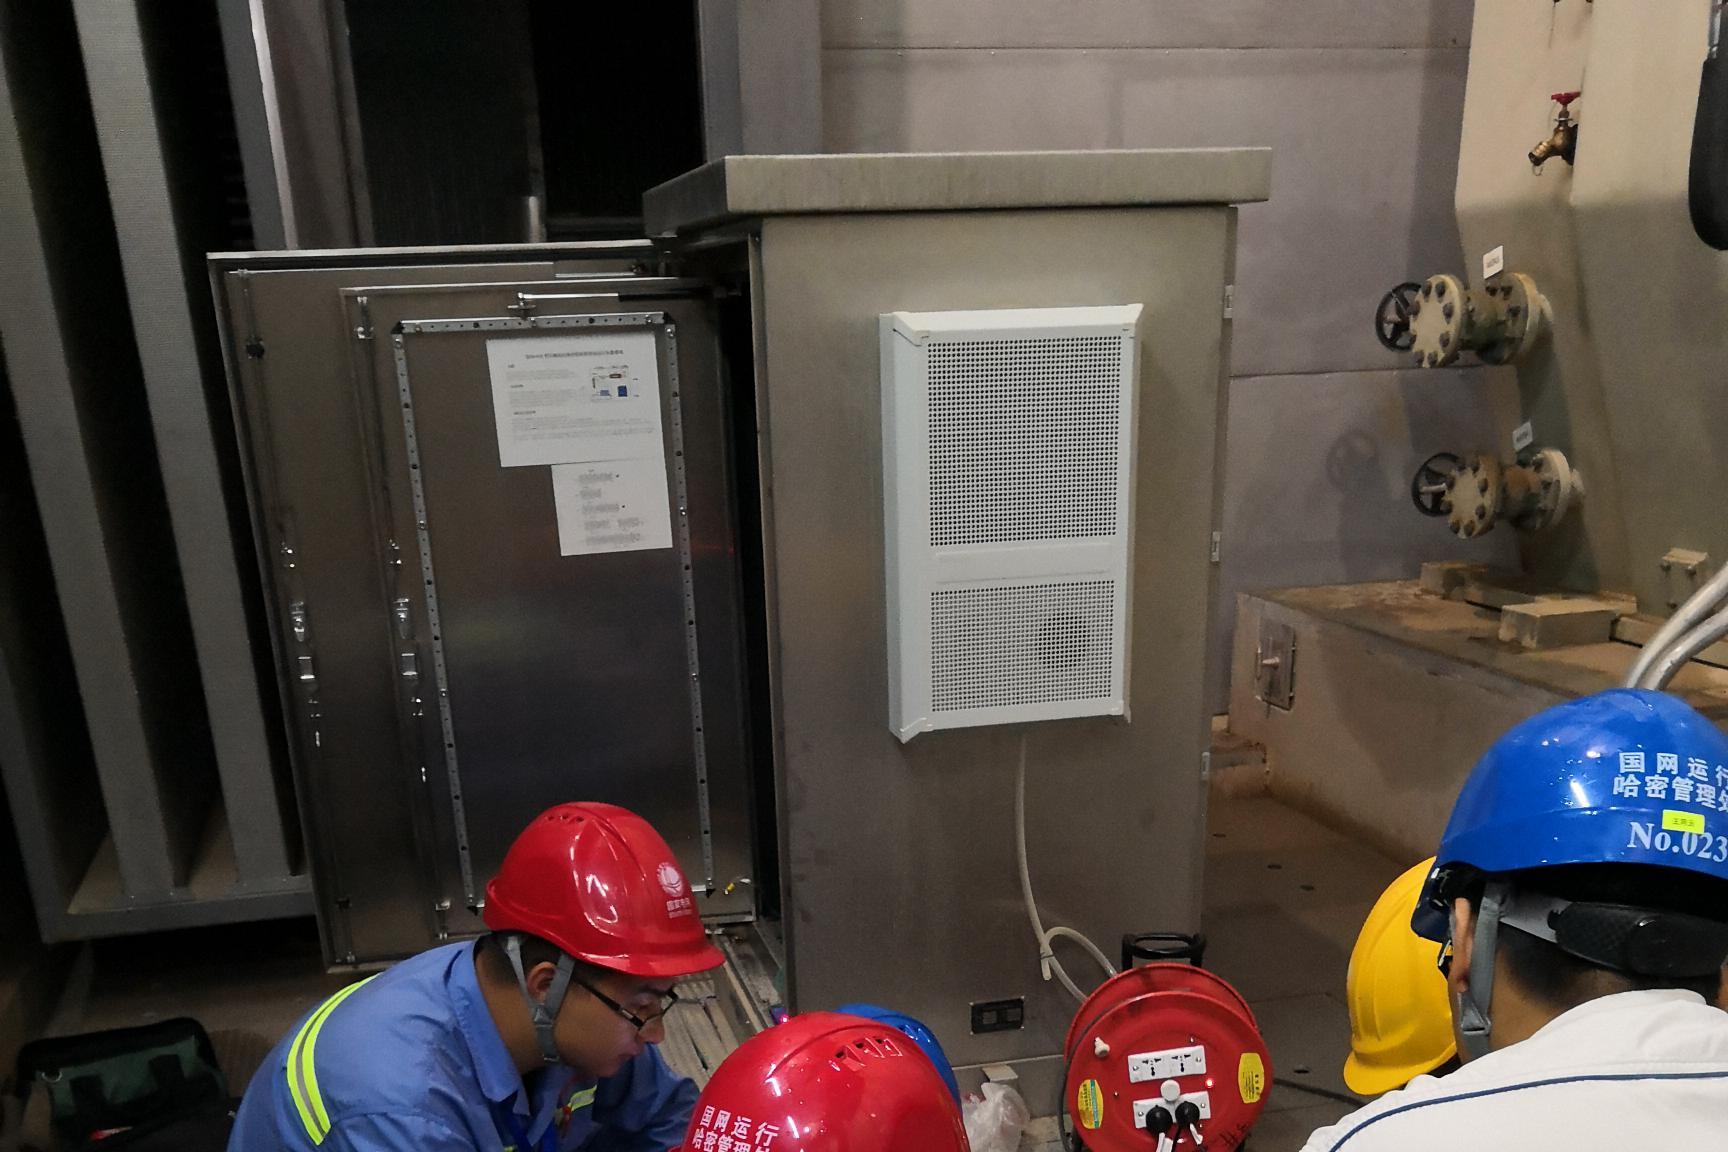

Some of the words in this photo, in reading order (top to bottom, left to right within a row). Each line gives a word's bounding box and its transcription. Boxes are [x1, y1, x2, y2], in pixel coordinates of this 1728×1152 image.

[1627, 822, 1728, 862] No.023
[700, 1105, 779, 1147] 国网运行
